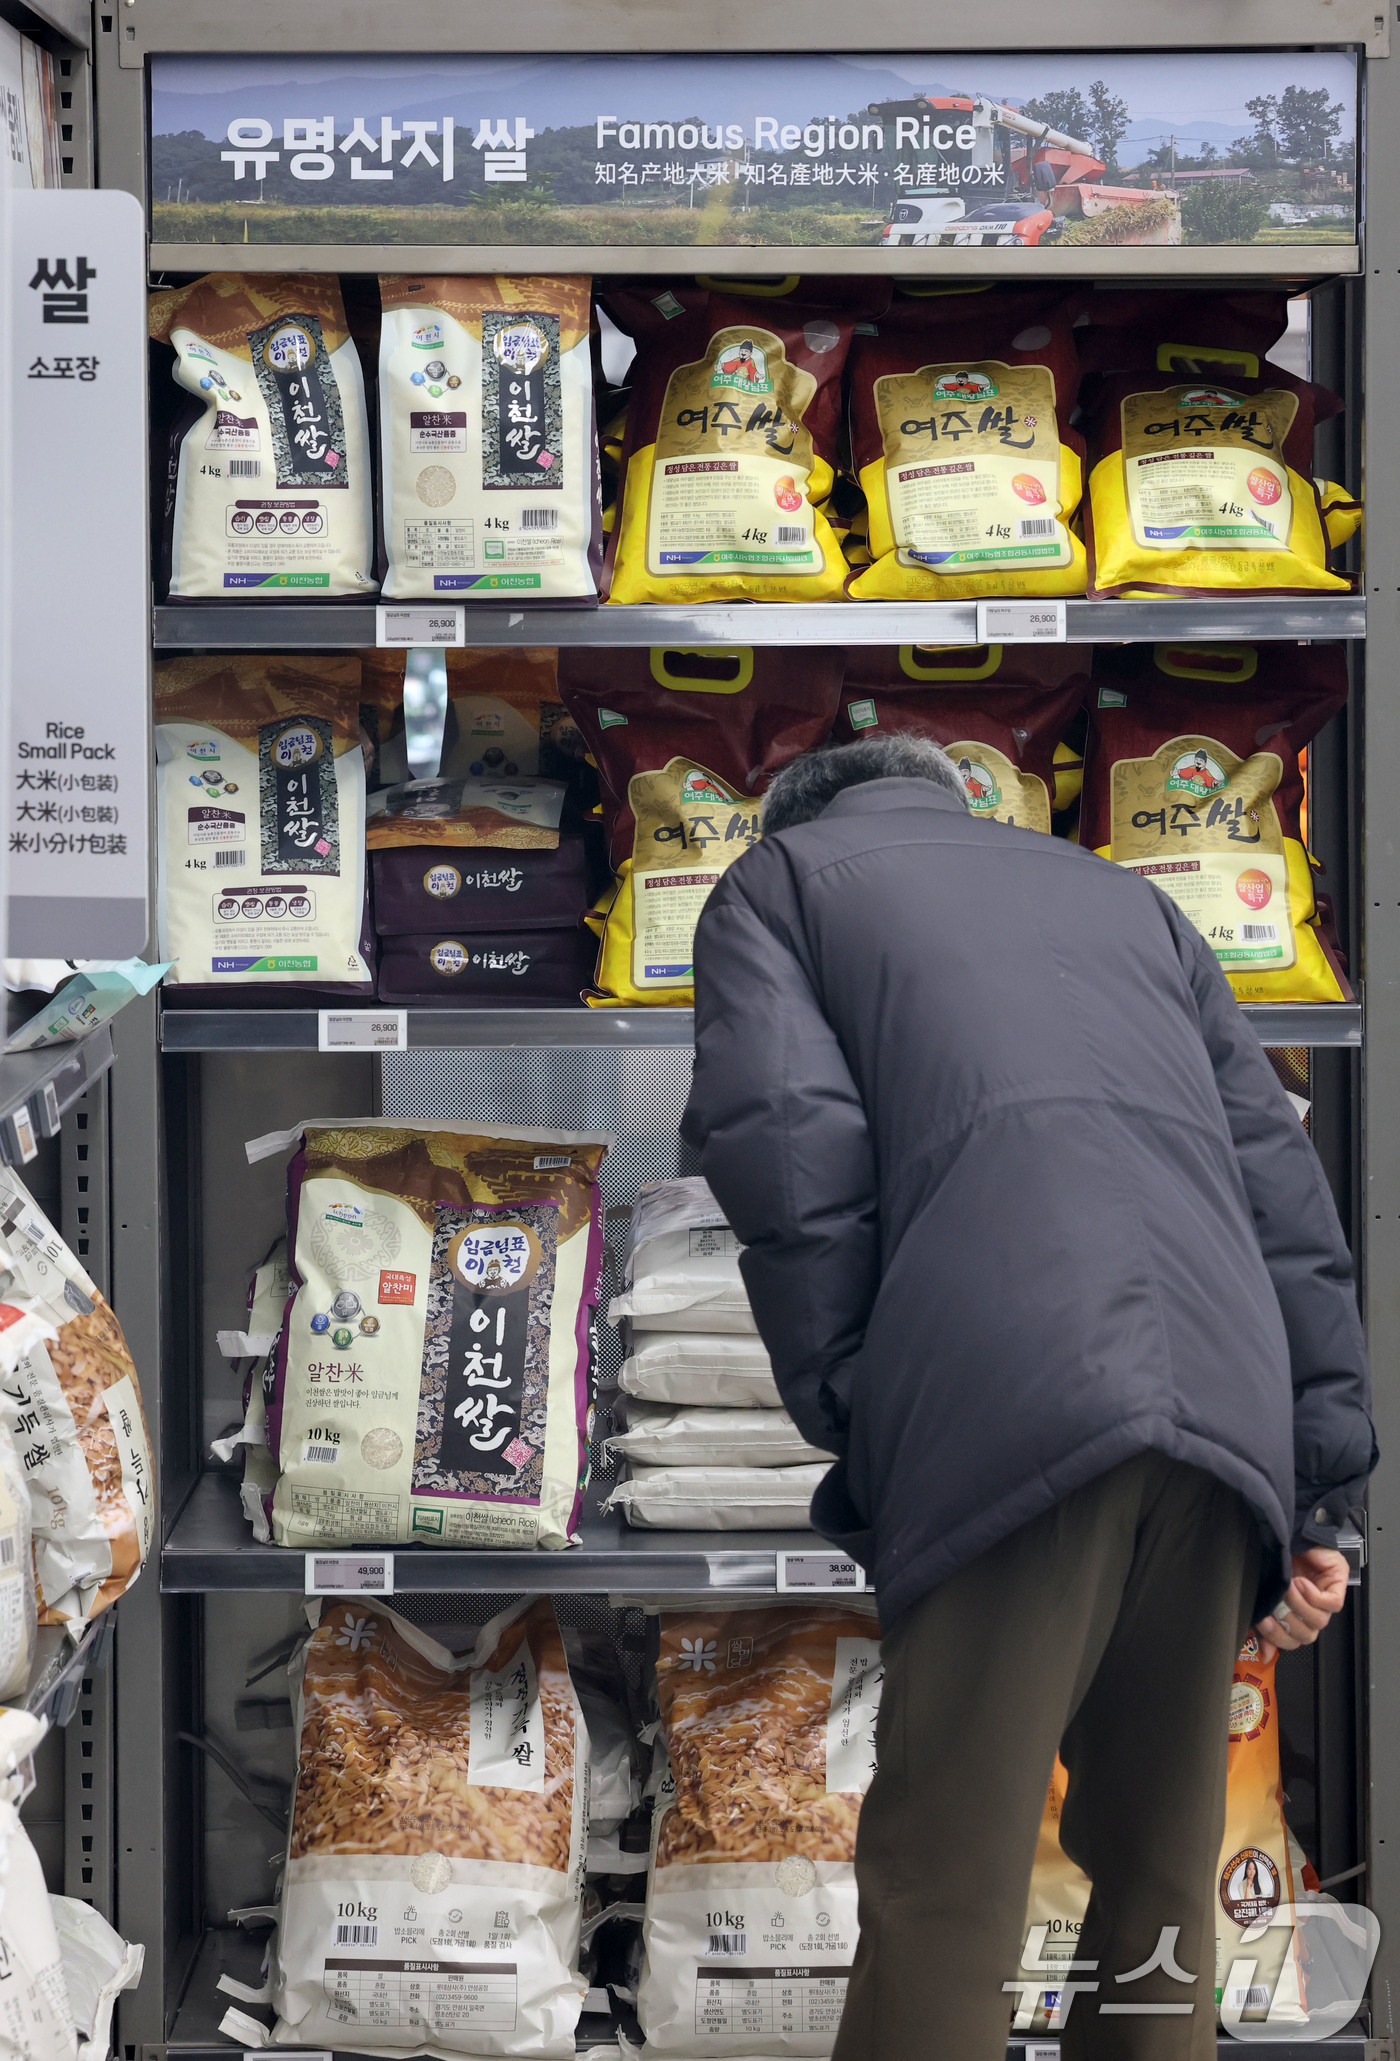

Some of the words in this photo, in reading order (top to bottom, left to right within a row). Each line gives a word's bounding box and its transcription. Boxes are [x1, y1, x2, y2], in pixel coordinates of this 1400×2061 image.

[596, 116, 744, 150] Famous
[755, 116, 884, 157] Region
[896, 116, 977, 150] Rice
[220, 116, 454, 182] 유명산지
[472, 117, 534, 182] 쌀
[29, 256, 97, 325] 쌀
[28, 355, 99, 381] 소포장
[713, 375, 732, 384] 여주
[734, 376, 769, 392] 대왕님표
[289, 377, 328, 460] 이천쌀
[423, 414, 452, 425] 알찬米
[505, 380, 541, 461] 이천쌀
[429, 619, 456, 628] 26,900
[1029, 614, 1056, 623] 26,900
[46, 722, 85, 739] Rice
[279, 734, 315, 750] 임금님표
[18, 742, 67, 759] Small
[71, 743, 116, 760] Pack
[16, 769, 118, 793] 大米(小包装)
[1169, 779, 1188, 788] 여주
[684, 791, 704, 800] 여주
[284, 773, 319, 847] 이천쌀
[9, 832, 128, 855] 米小分け包装
[465, 868, 523, 892] 이천쌀
[472, 951, 531, 976] 이천쌀
[371, 1024, 398, 1032] 26,900
[463, 1235, 527, 1257] 임금님표
[382, 1282, 413, 1295] 알찬미
[308, 1362, 364, 1383] 알찬米
[453, 1307, 516, 1451] 이천쌀
[306, 1388, 332, 1397] 이천쌀은
[334, 1388, 354, 1397] 밥맛이
[371, 1391, 399, 1400] 임금님께
[305, 1399, 331, 1408] 진상하던
[465, 1512, 489, 1524] 이천쌀
[489, 1514, 516, 1526] (Icheon
[518, 1516, 538, 1528] Rice)
[357, 1567, 384, 1575] 49,900
[829, 1564, 856, 1573] 38,900
[403, 1962, 439, 1971] 품질표시사항
[774, 1969, 810, 1977] 품질표시사항
